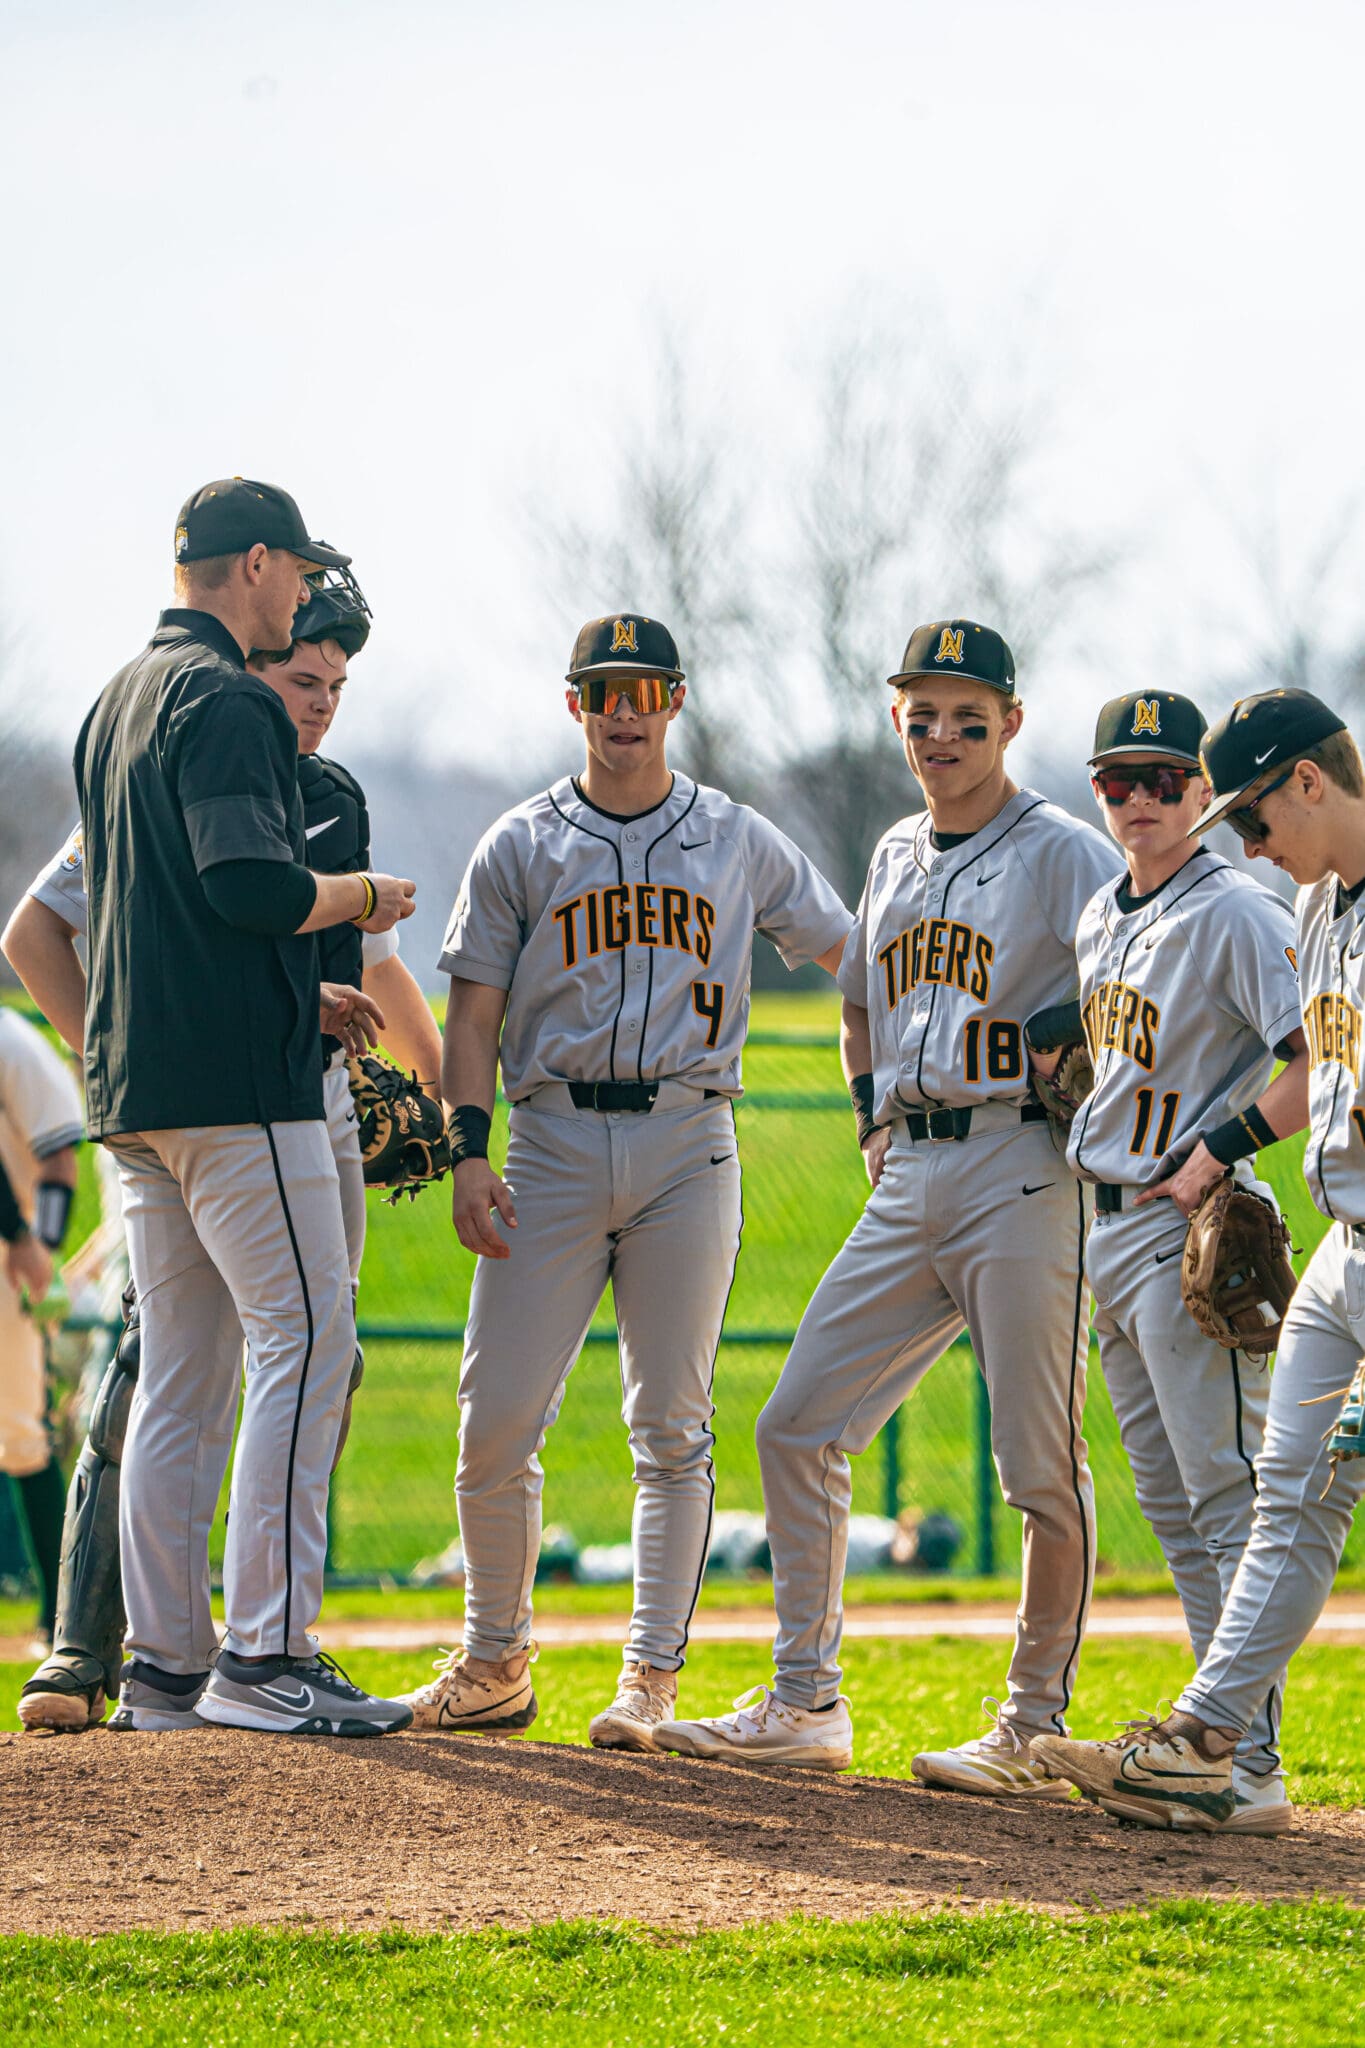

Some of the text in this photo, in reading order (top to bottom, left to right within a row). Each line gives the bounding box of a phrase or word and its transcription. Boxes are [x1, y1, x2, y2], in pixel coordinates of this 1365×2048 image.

[553, 882, 716, 970] TIGERS
[878, 918, 994, 1012] TIGERS
[692, 980, 724, 1049] 4
[964, 1017, 1024, 1084] 18
[1128, 1086, 1181, 1159] 11
